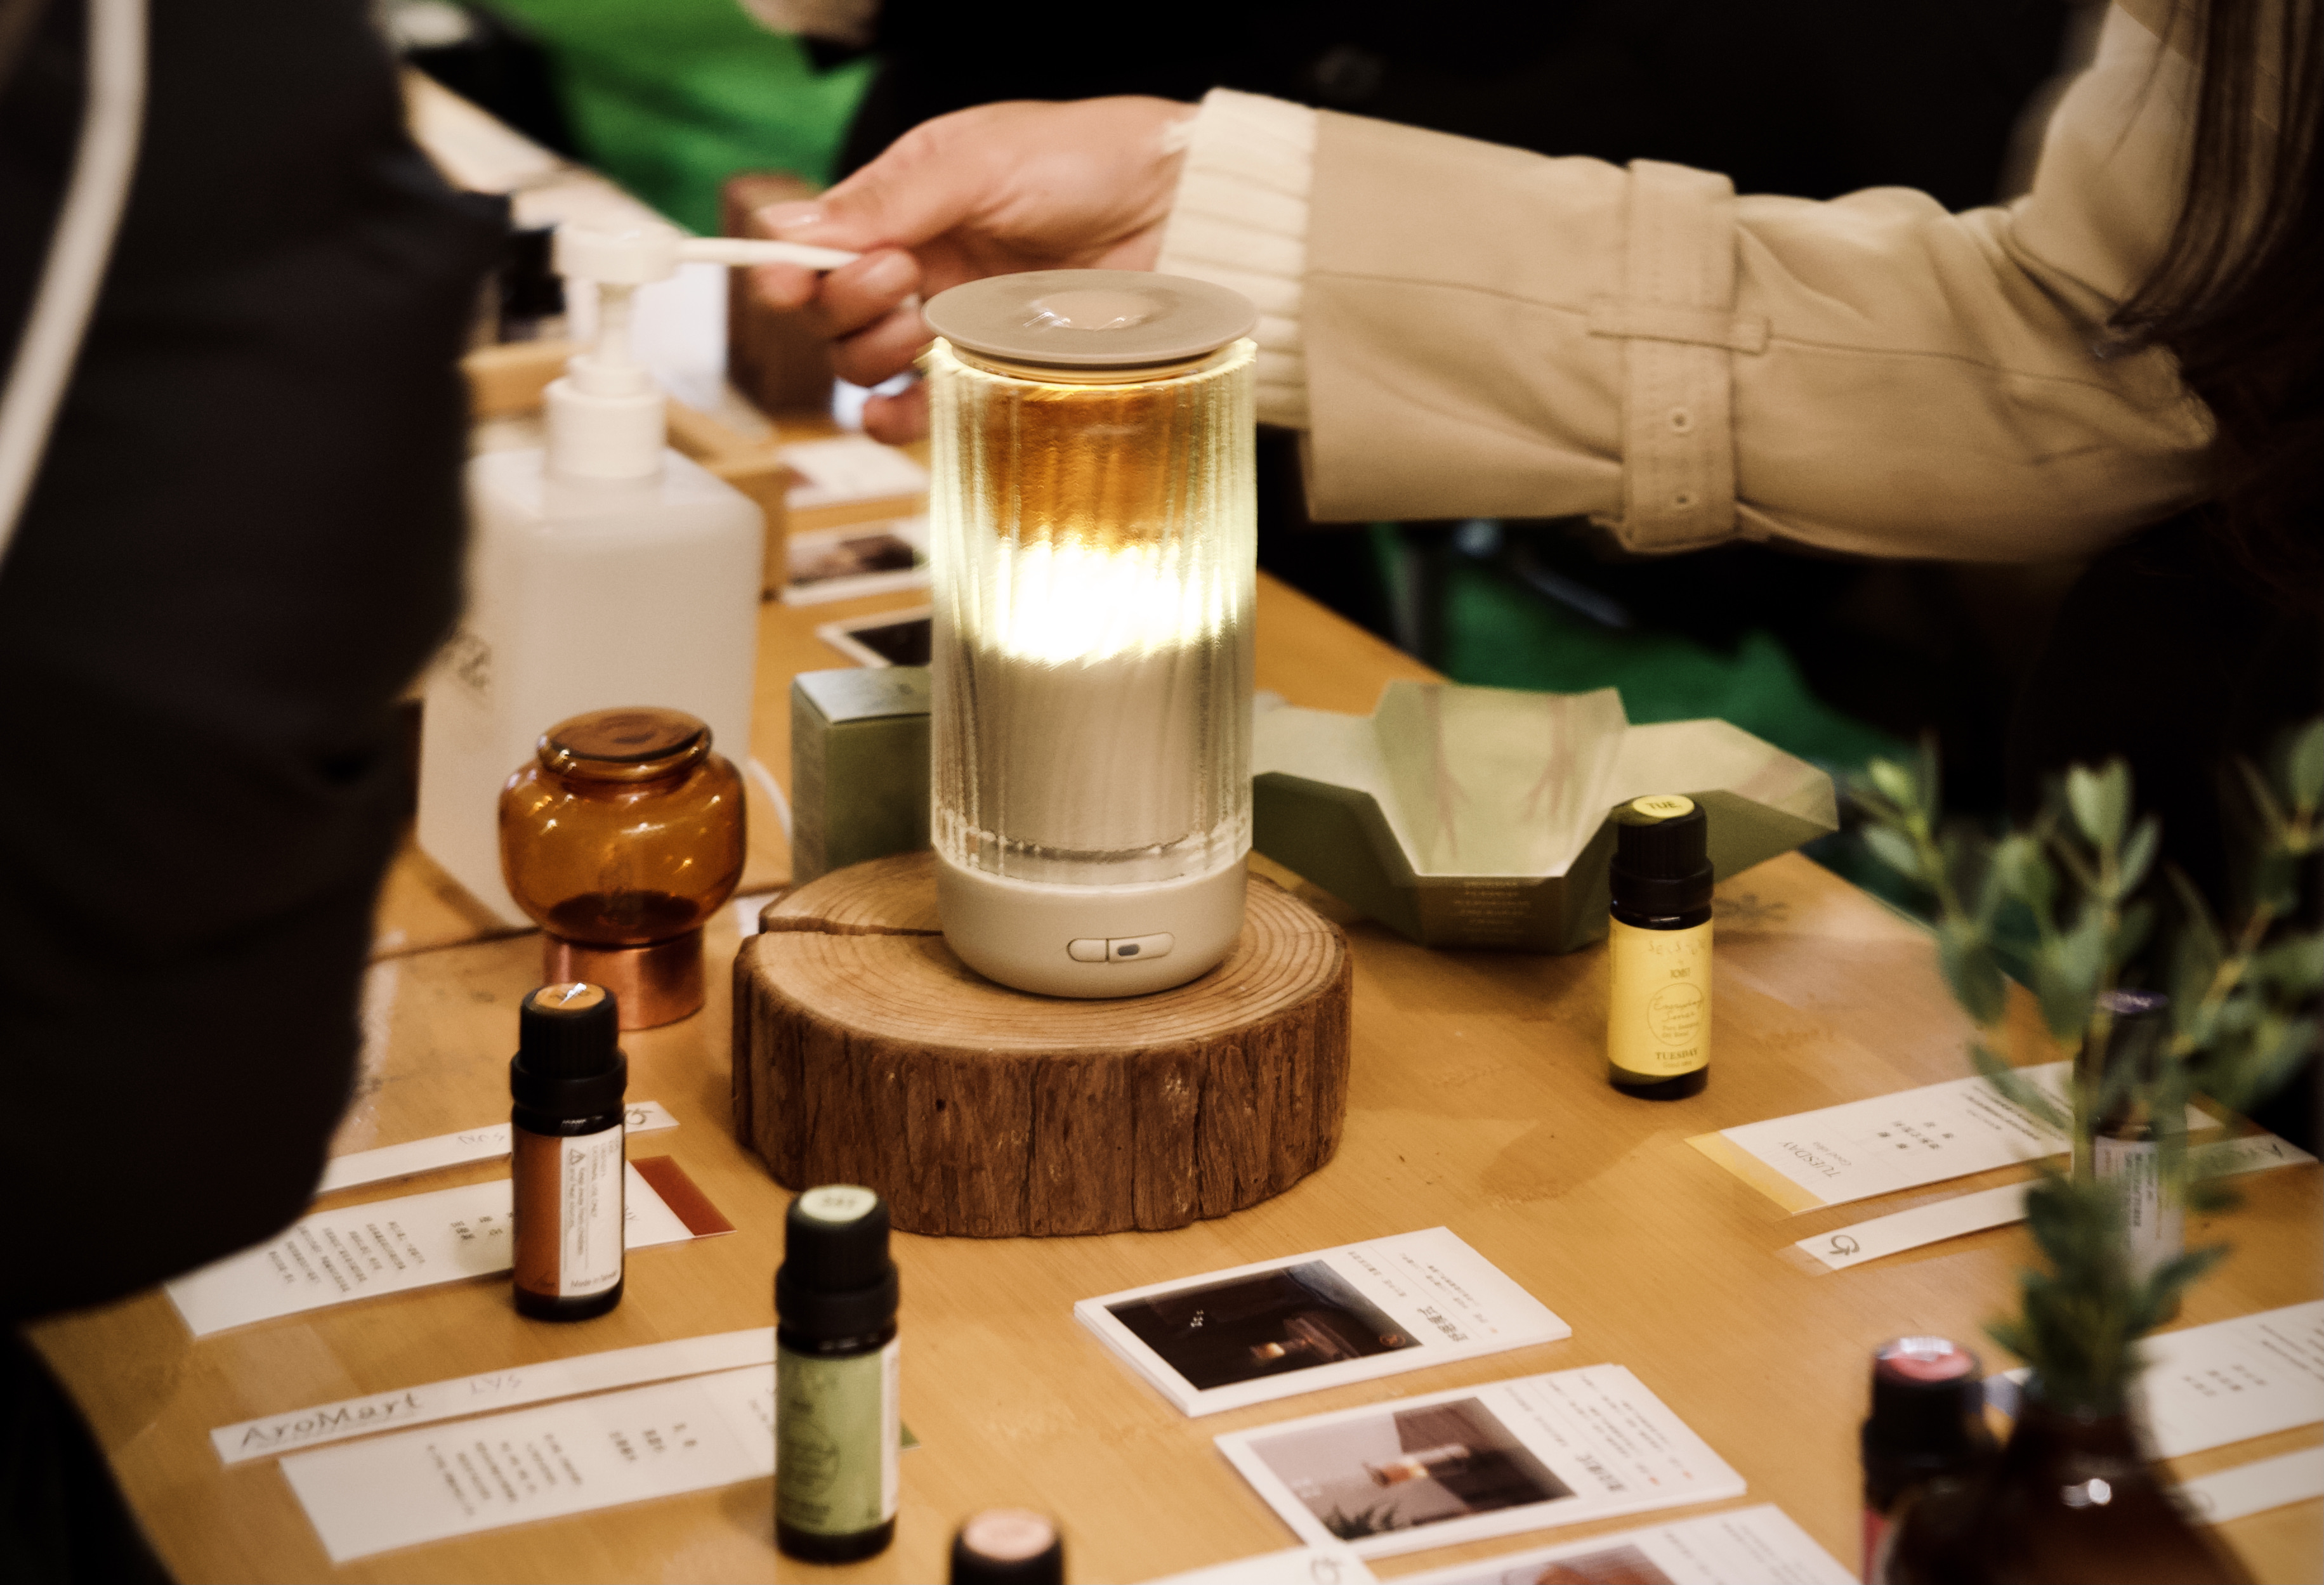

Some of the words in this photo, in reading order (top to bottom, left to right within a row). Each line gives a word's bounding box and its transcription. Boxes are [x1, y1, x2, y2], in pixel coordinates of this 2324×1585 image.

[1655, 1047, 1698, 1060] TUESDAY
[1778, 1141, 1841, 1178] TUESDAY
[240, 1392, 421, 1448] AroMart
